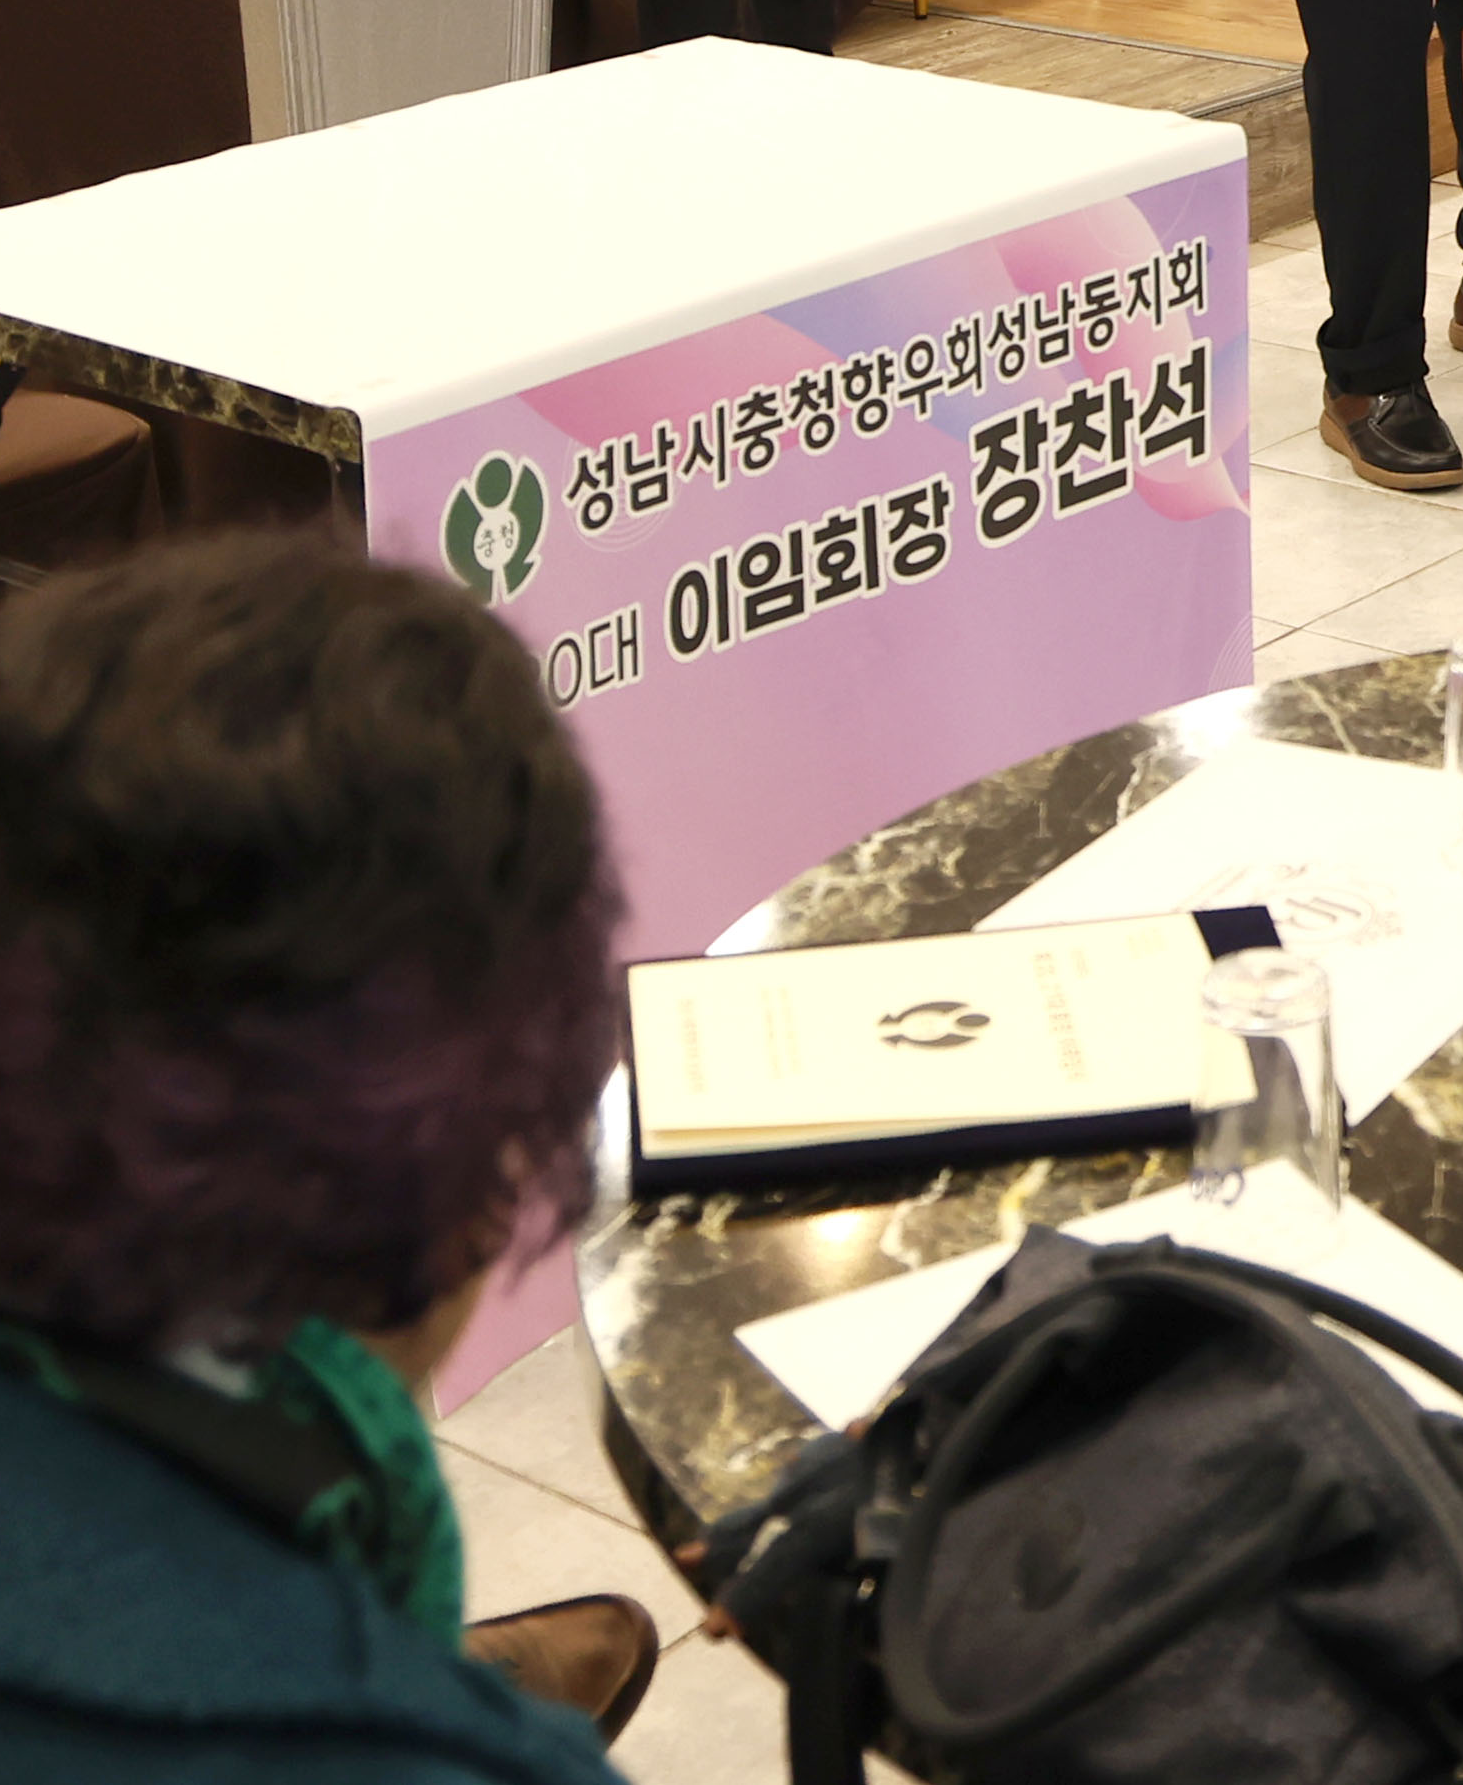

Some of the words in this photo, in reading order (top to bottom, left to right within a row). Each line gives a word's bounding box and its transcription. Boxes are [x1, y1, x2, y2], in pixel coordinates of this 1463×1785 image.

[566, 239, 1209, 532] 성남시충청향우회성남동지회
[669, 481, 950, 656] 이임회장
[974, 348, 1210, 540] 장찬석
